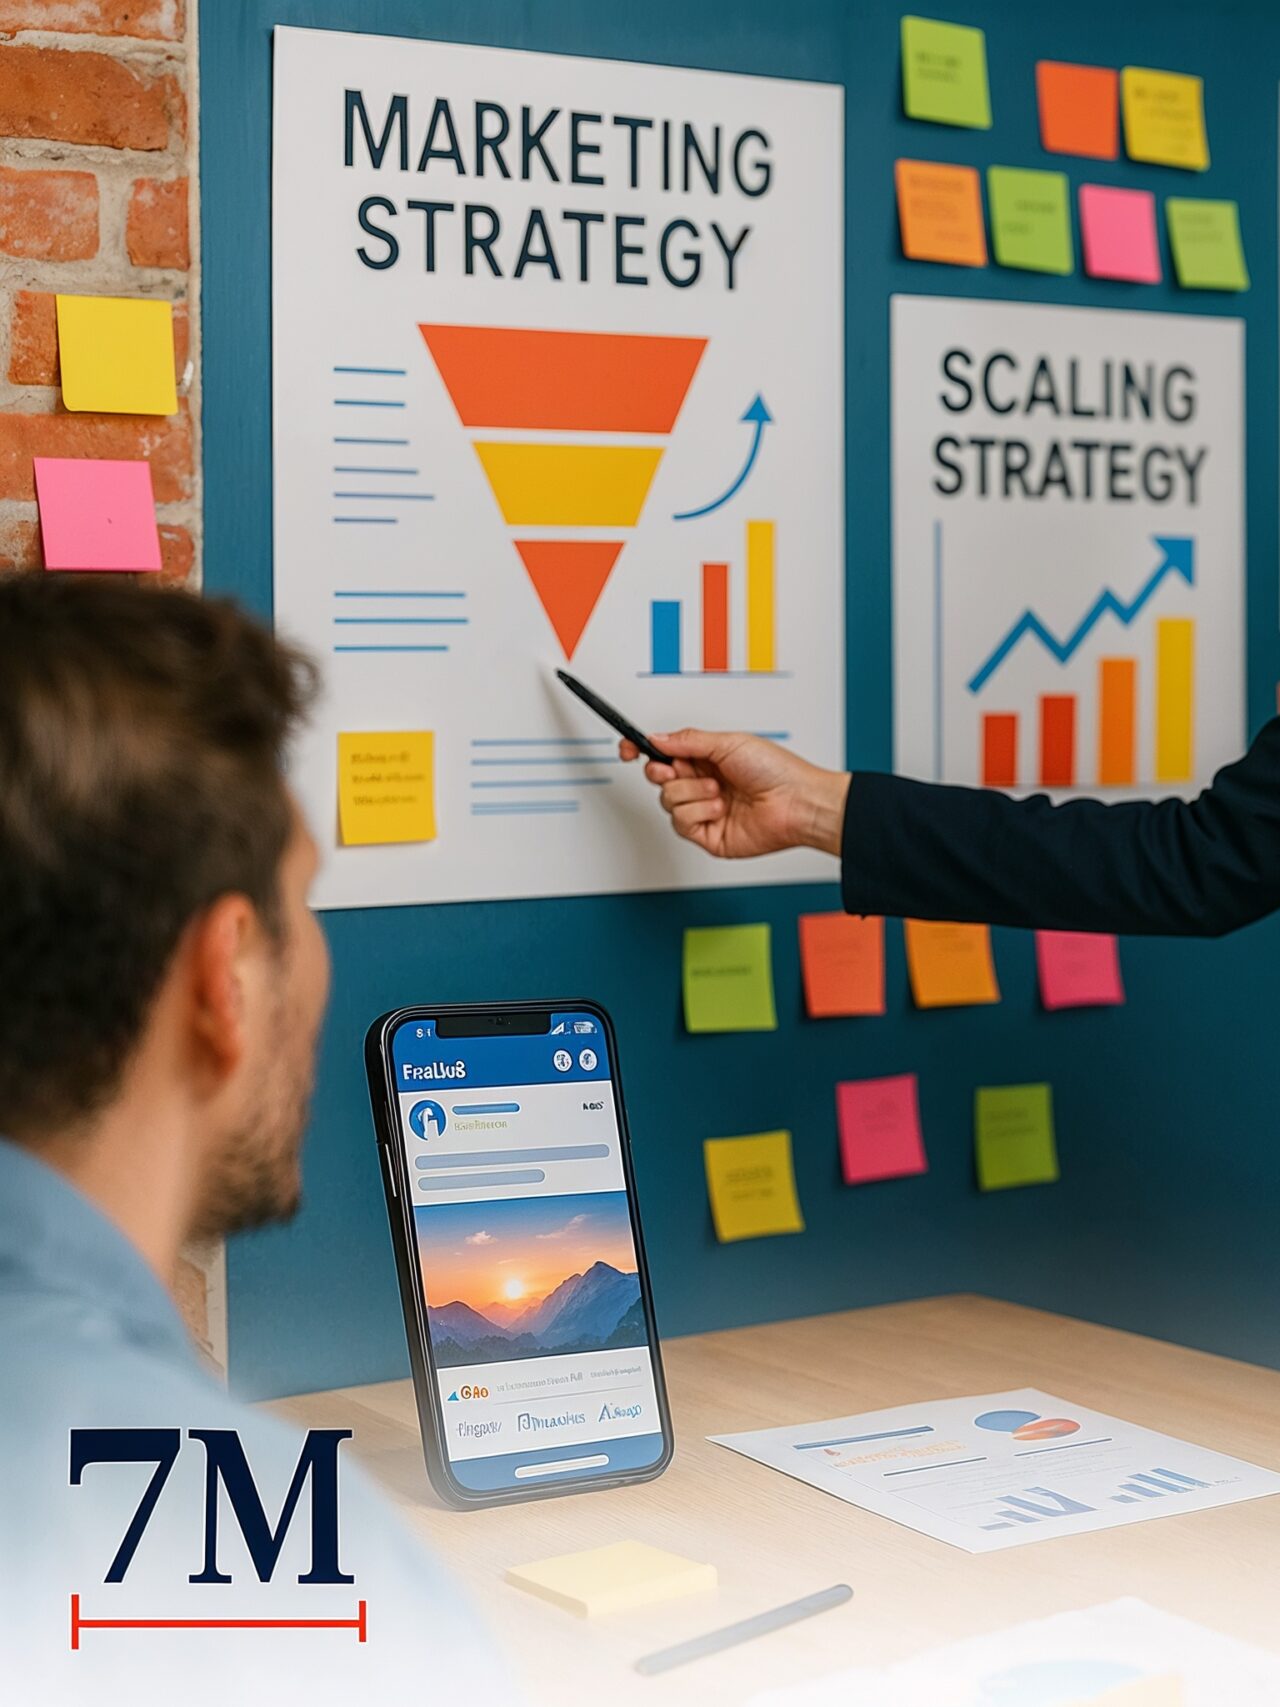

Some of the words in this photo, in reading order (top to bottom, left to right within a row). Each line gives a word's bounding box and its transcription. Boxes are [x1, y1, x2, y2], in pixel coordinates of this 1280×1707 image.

[344, 89, 772, 197] MARKETING
[356, 196, 750, 289] STRATEGY
[940, 349, 1196, 423] SCALING
[933, 436, 1208, 505] STRATEGY
